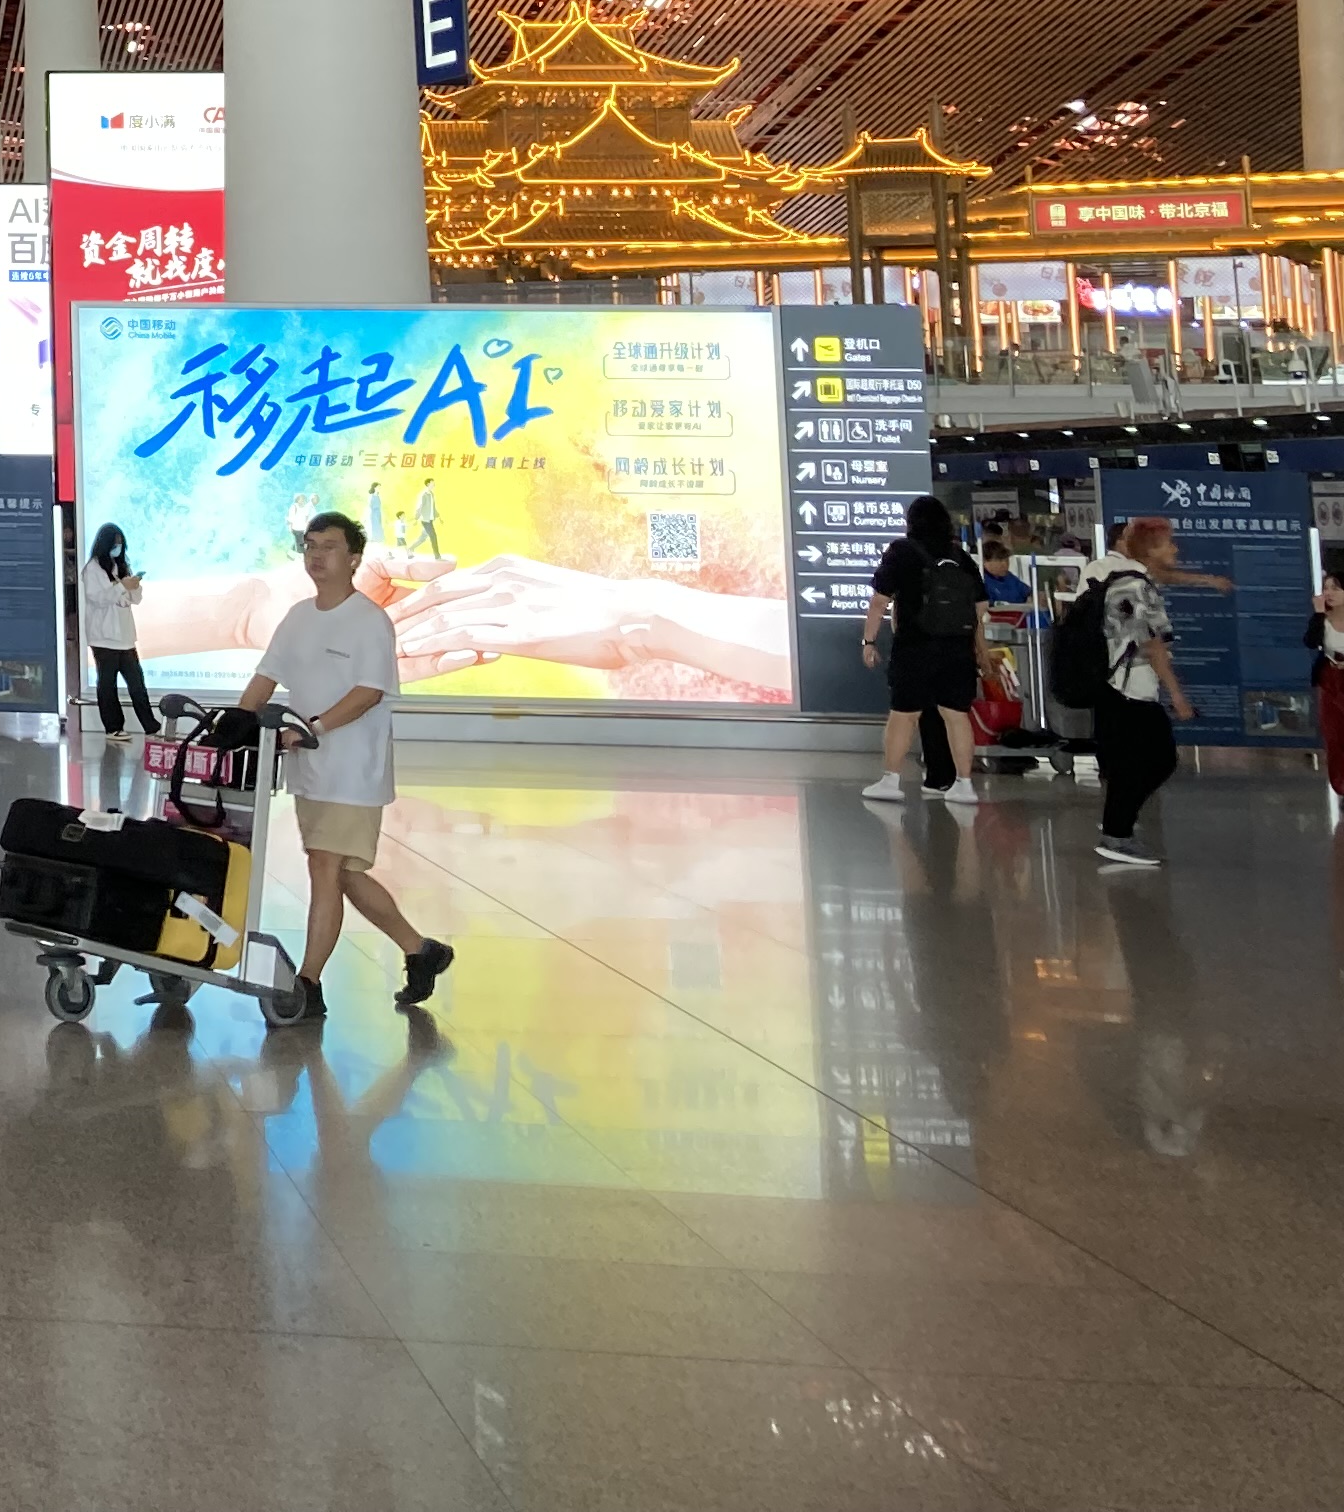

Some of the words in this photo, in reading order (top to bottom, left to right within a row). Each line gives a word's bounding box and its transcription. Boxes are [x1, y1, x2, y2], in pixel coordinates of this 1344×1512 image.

[128, 114, 176, 129] 度小满
[8, 197, 48, 226] AI
[79, 222, 194, 268] 资金周转
[125, 247, 224, 288] 就找度
[128, 319, 176, 330] 中国移动
[612, 341, 721, 360] 全球通升级计划
[844, 338, 880, 350] 登机口
[844, 353, 871, 362] Gates
[612, 400, 722, 419] 移动爱家计划
[875, 419, 913, 432] 洗手间
[875, 434, 901, 444] Toilet
[615, 457, 724, 476] 网龄成长计划
[851, 460, 889, 473] 母婴室
[851, 476, 887, 486] Nursery
[853, 501, 904, 515] 货币兑换
[853, 517, 887, 527] Currency
[888, 517, 907, 526] Exch
